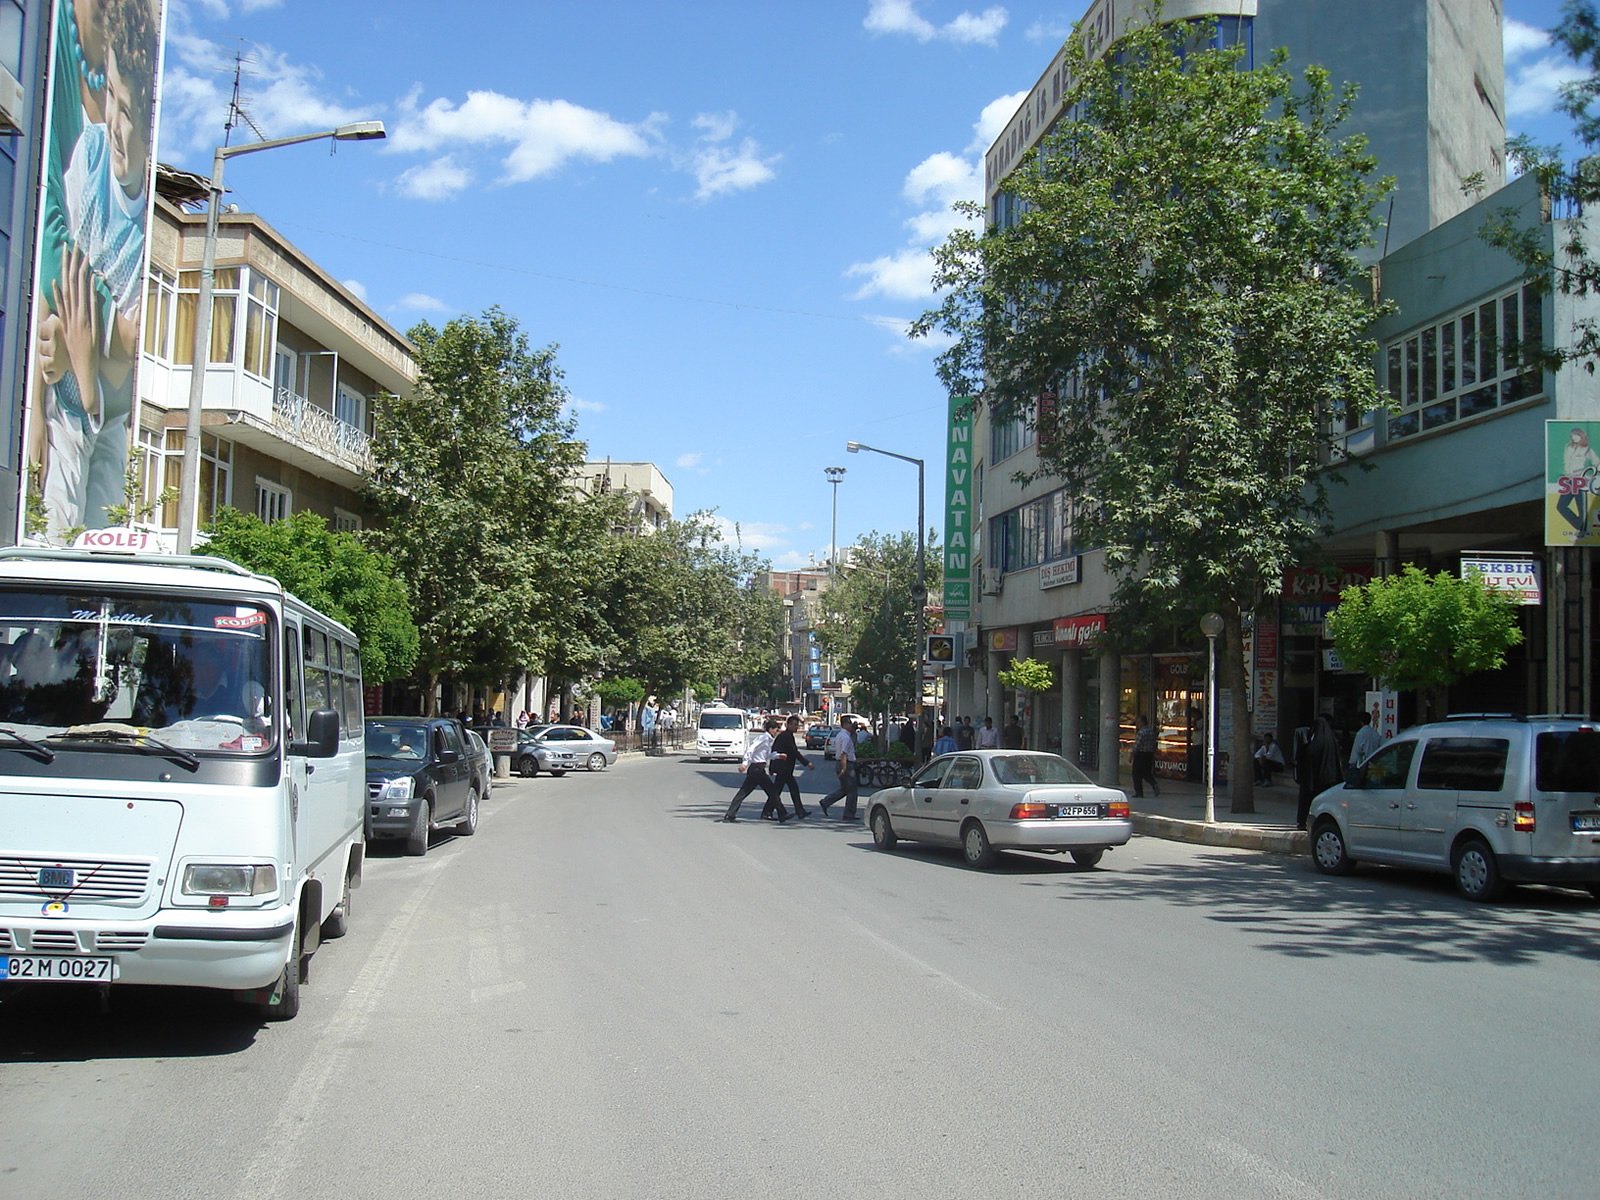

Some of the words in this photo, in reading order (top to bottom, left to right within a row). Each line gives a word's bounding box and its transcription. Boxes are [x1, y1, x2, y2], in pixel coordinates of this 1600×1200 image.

[986, 103, 1031, 190] KARADAĞ
[1036, 87, 1047, 128] İŞ
[949, 406, 969, 569] NAVATAN
[84, 533, 148, 549] KOLEJ
[1506, 575, 1533, 586] EVİ
[215, 615, 265, 627] KOLEJ
[1155, 760, 1187, 772] KUYUMCU
[1063, 807, 1072, 815] 02
[1073, 807, 1082, 815] FP
[1083, 807, 1096, 815] 656
[9, 959, 34, 976] 02
[38, 959, 52, 977] M
[59, 960, 109, 977] 0027
